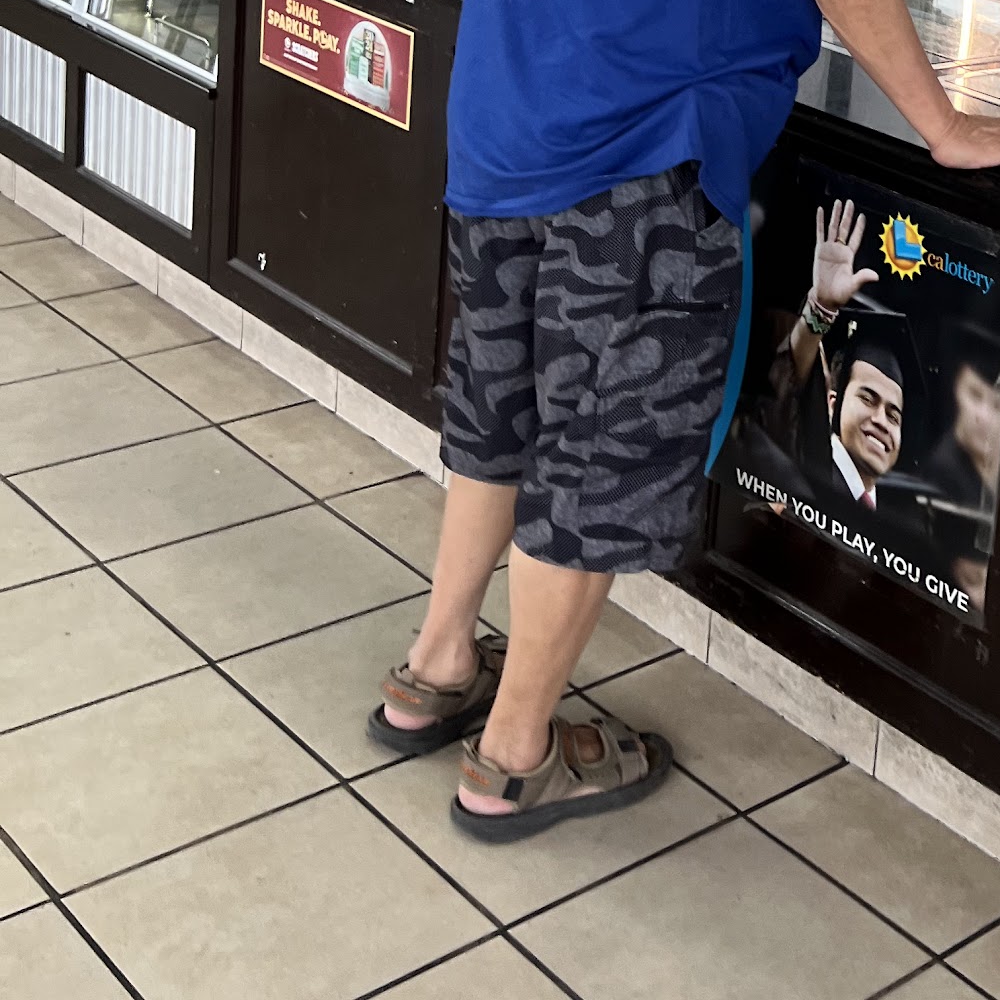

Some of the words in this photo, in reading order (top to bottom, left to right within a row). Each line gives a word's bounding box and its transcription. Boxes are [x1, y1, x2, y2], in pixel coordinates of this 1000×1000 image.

[267, 9, 312, 40] SPARKLE.
[926, 250, 995, 294] calottery
[736, 467, 788, 510] WHEN
[791, 496, 827, 531] YOU
[831, 518, 878, 564] PLAY,
[882, 546, 921, 584] YOU
[925, 572, 970, 613] GIVE
